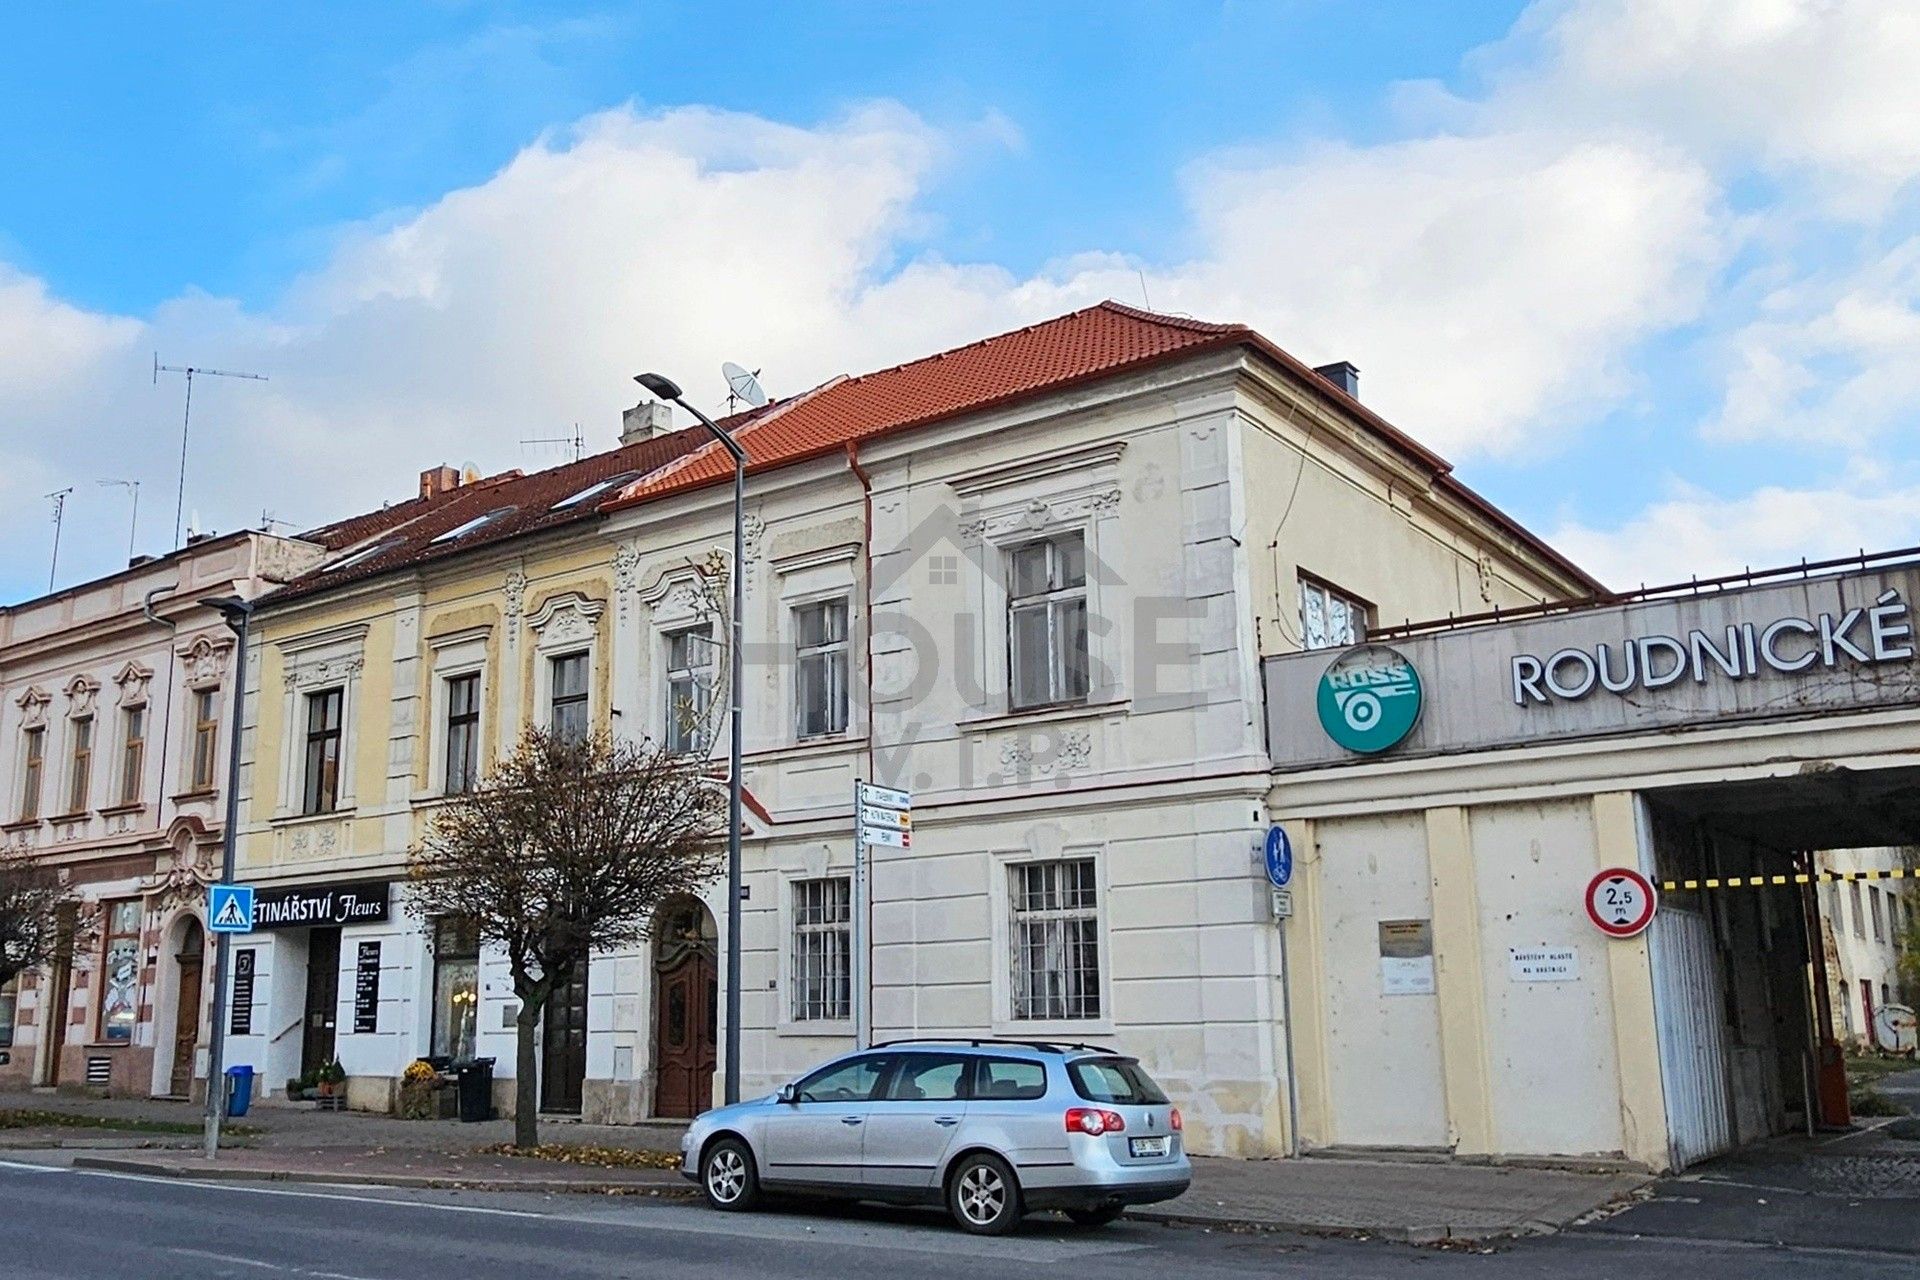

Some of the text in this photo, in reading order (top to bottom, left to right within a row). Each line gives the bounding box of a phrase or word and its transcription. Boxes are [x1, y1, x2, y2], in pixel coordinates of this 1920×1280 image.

[1511, 588, 1914, 706] ROUDNICKÉ
[1328, 664, 1411, 691] ROSS
[335, 894, 381, 922] Fleurs
[1615, 907, 1627, 915] m
